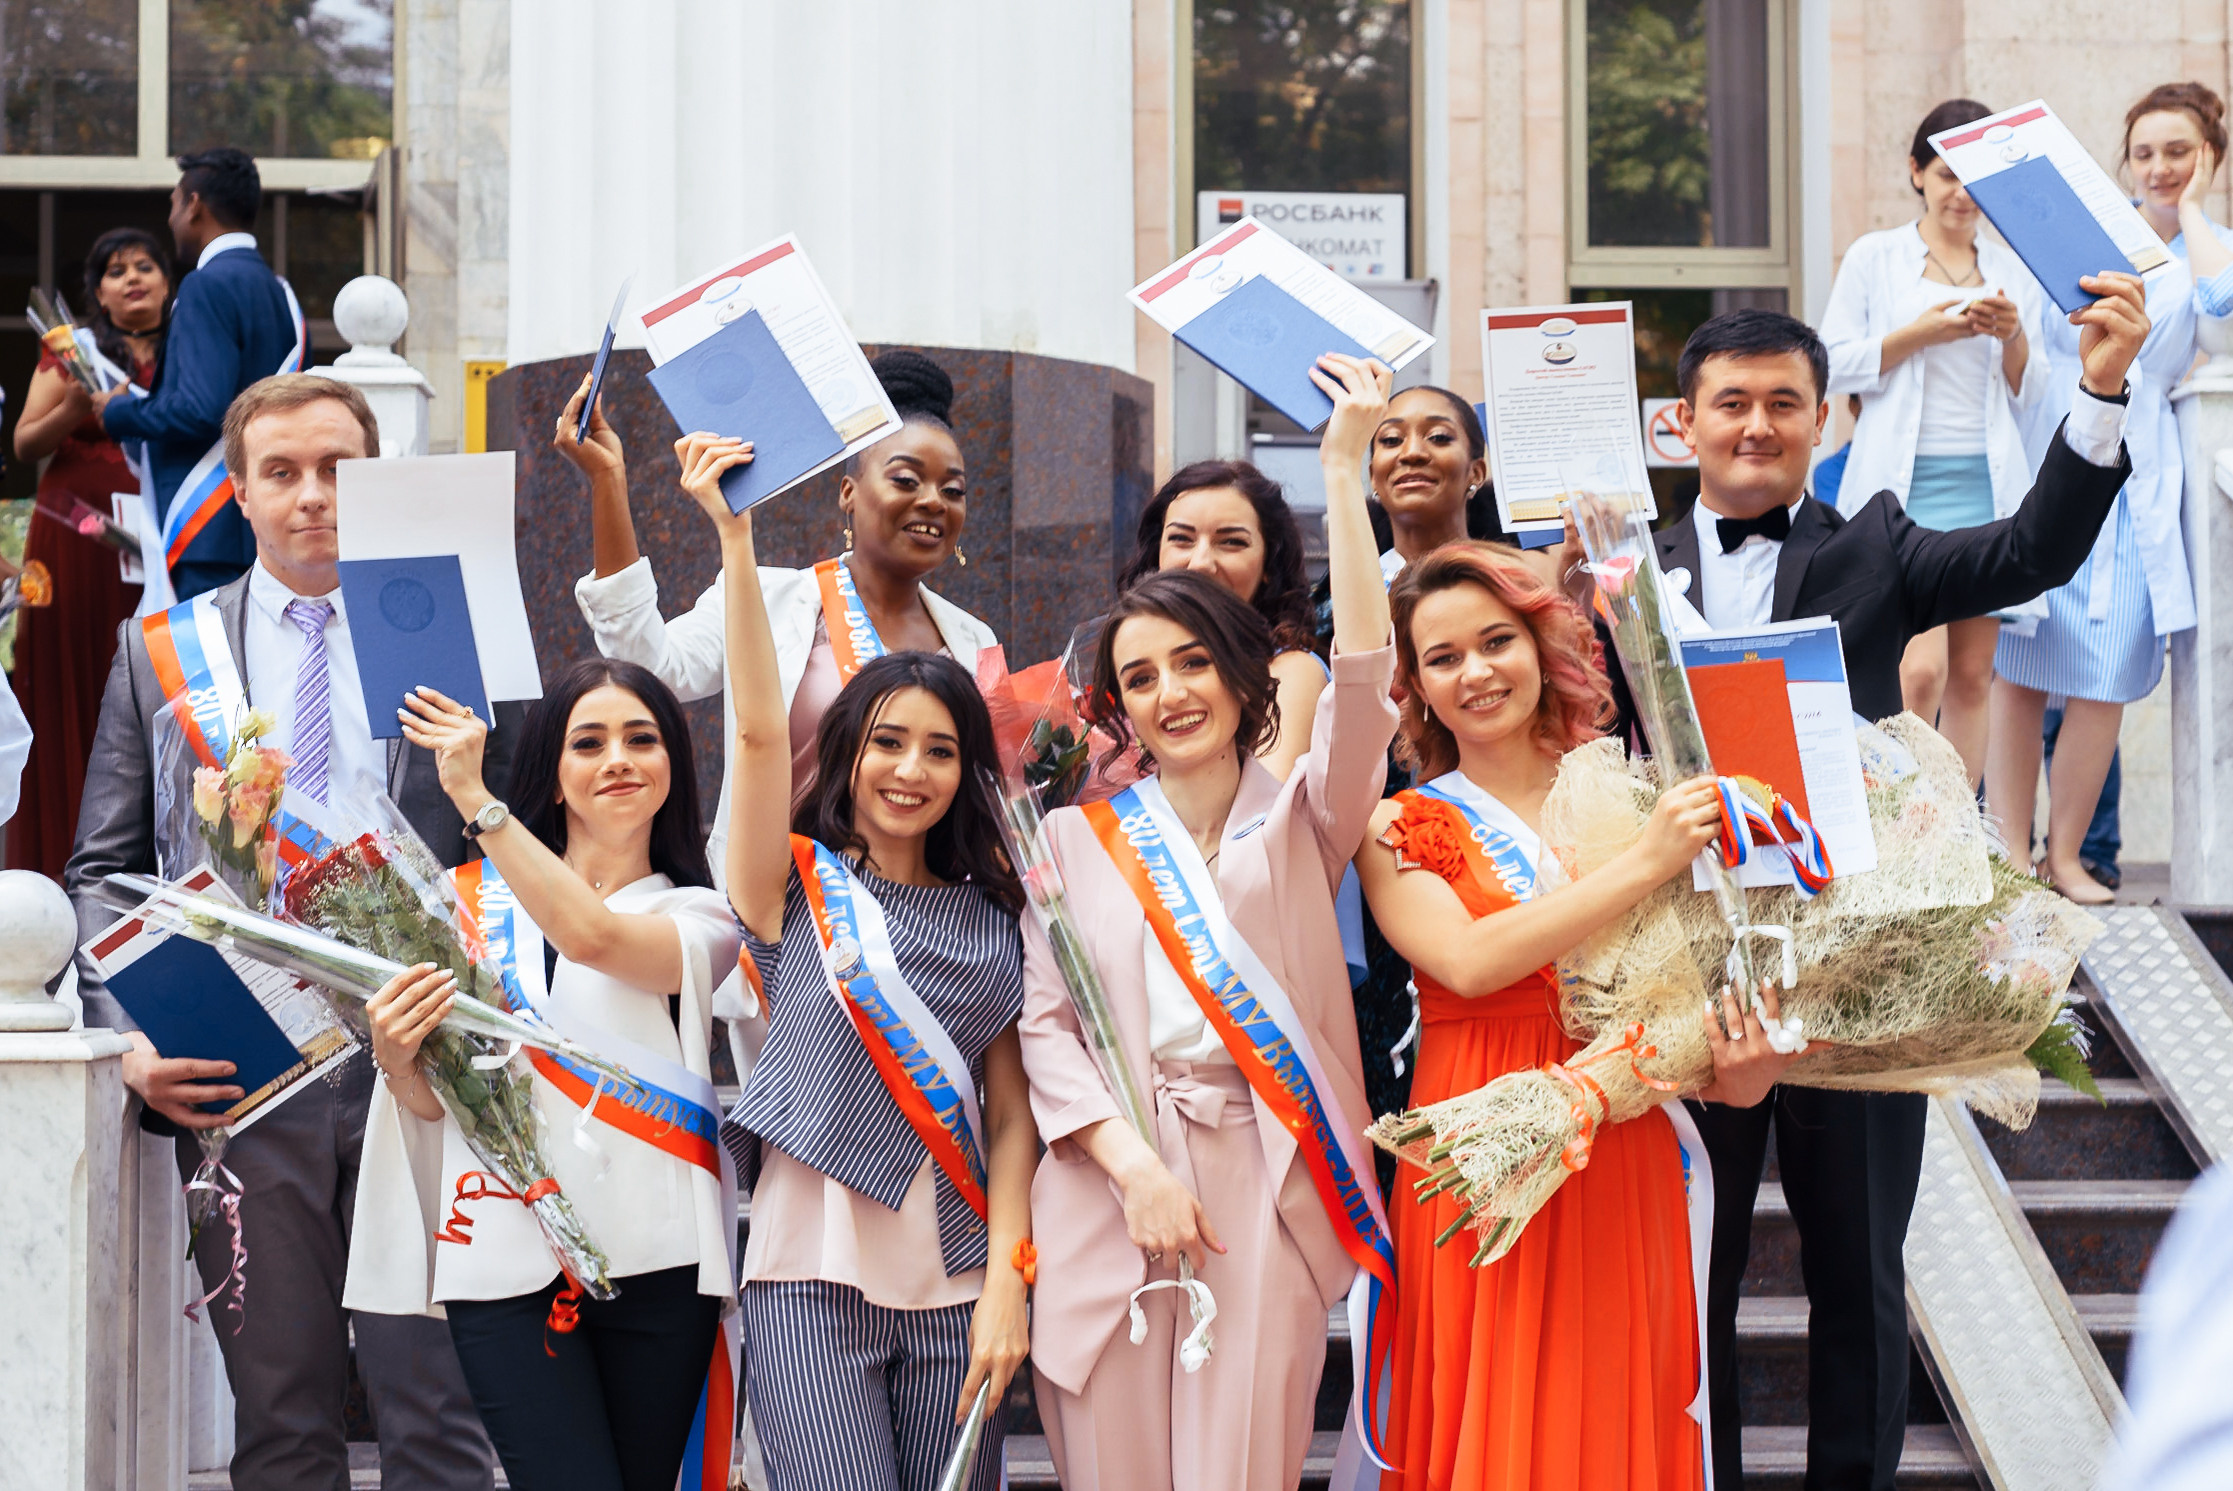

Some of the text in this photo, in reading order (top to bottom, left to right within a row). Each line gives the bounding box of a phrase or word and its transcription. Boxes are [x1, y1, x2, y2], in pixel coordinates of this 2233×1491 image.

[1252, 203, 1383, 222] РОСБАНК
[185, 687, 222, 724] 80
[1119, 810, 1164, 848] 80
[475, 879, 513, 911] 80
[1140, 849, 1187, 914] лет
[1252, 1034, 1334, 1157] Выпуск
[1335, 1169, 1384, 1251] 2018
